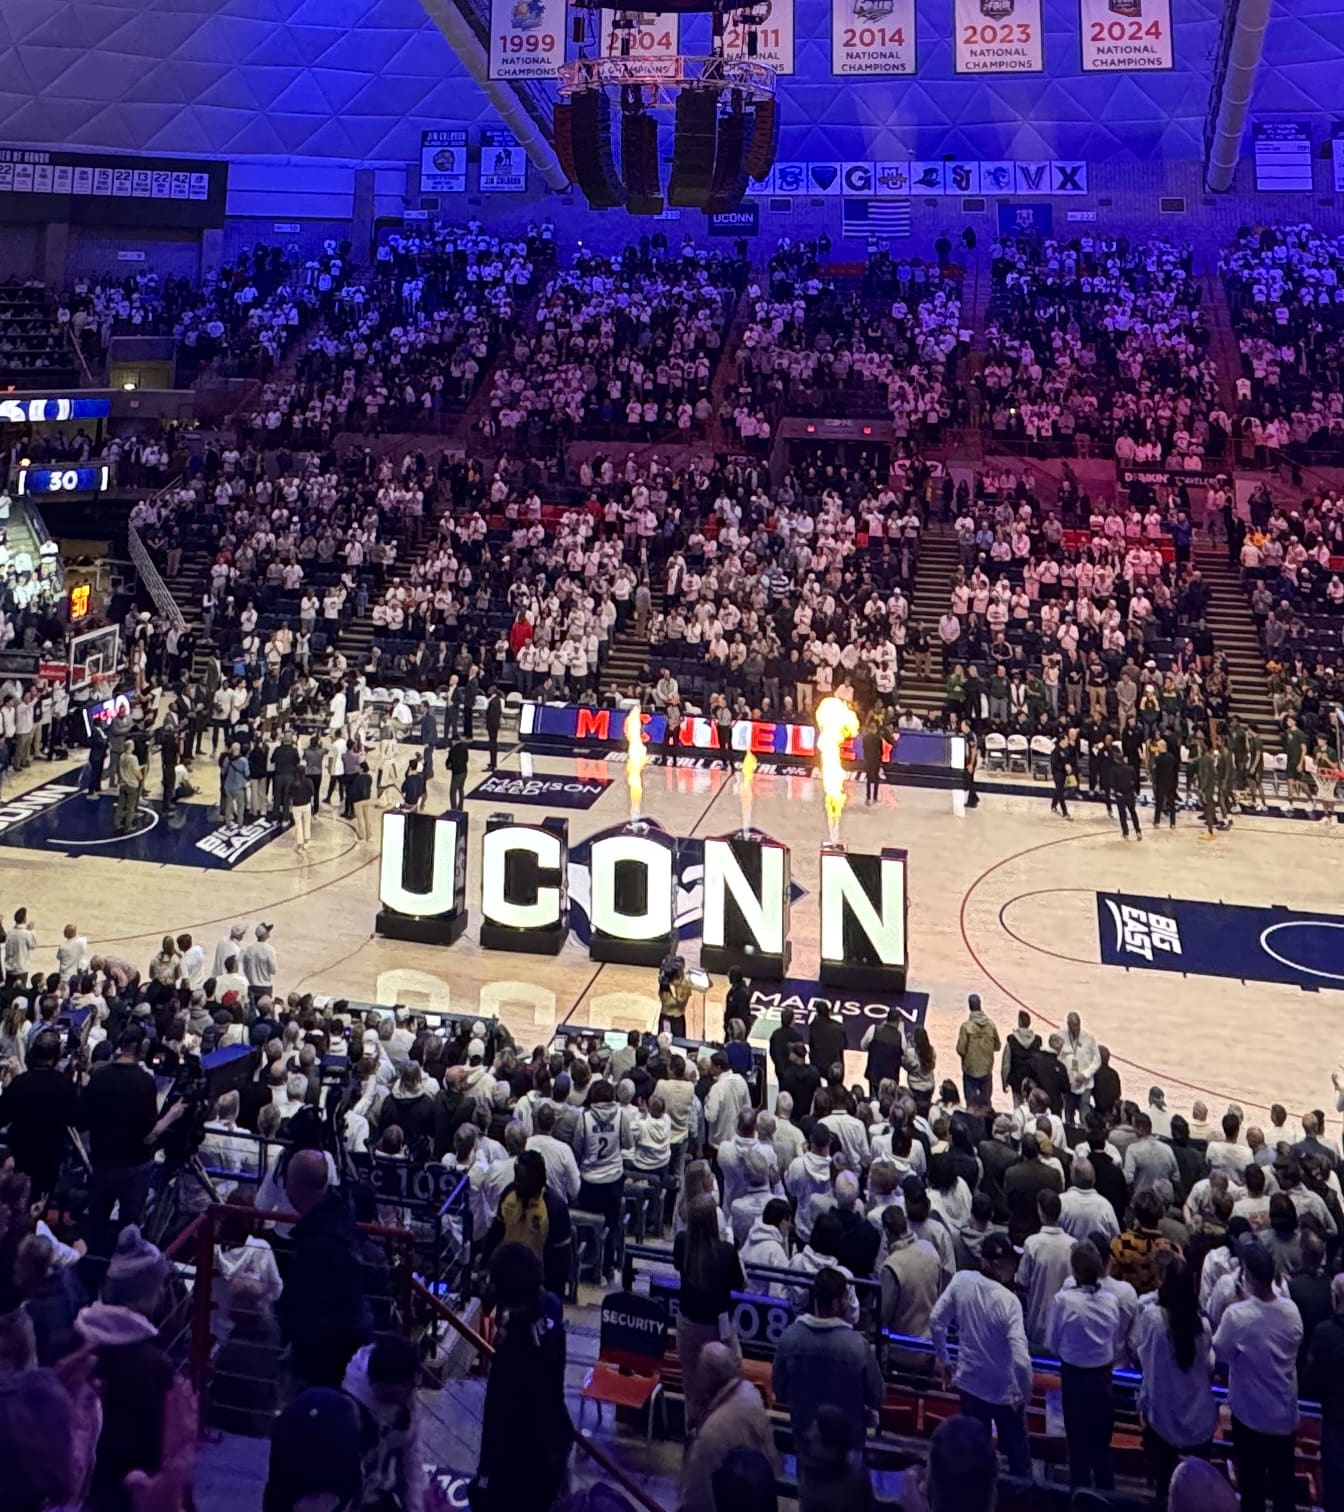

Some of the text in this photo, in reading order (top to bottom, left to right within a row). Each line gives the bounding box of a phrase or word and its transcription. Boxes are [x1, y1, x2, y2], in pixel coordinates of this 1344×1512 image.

[843, 28, 904, 47] 2014
[963, 24, 1031, 45] 2023
[1090, 20, 1162, 41] 2024
[499, 34, 555, 53] 1999
[970, 49, 1028, 57] NATIONAL
[1097, 45, 1157, 55] NATIONAL
[502, 57, 551, 65] NATIONAL
[846, 52, 901, 60] NATIONAL
[965, 60, 1032, 70] CHAMPIONS
[1092, 58, 1162, 67] CHAMPIONS
[497, 68, 556, 76] CHAMPIONS
[841, 63, 906, 72] CHAMPIONS
[713, 211, 754, 224] UCONN
[49, 471, 78, 491] 30
[479, 783, 541, 795] REED
[487, 777, 602, 794] MADISON
[210, 818, 273, 860] EAST
[379, 813, 906, 966] UCONN
[1118, 903, 1155, 961] EAST
[1147, 911, 1183, 955] BIG
[751, 991, 919, 1023] MADISON
[597, 1137, 608, 1160] 2
[396, 1165, 457, 1199] 109
[601, 1307, 665, 1336] SECURITY
